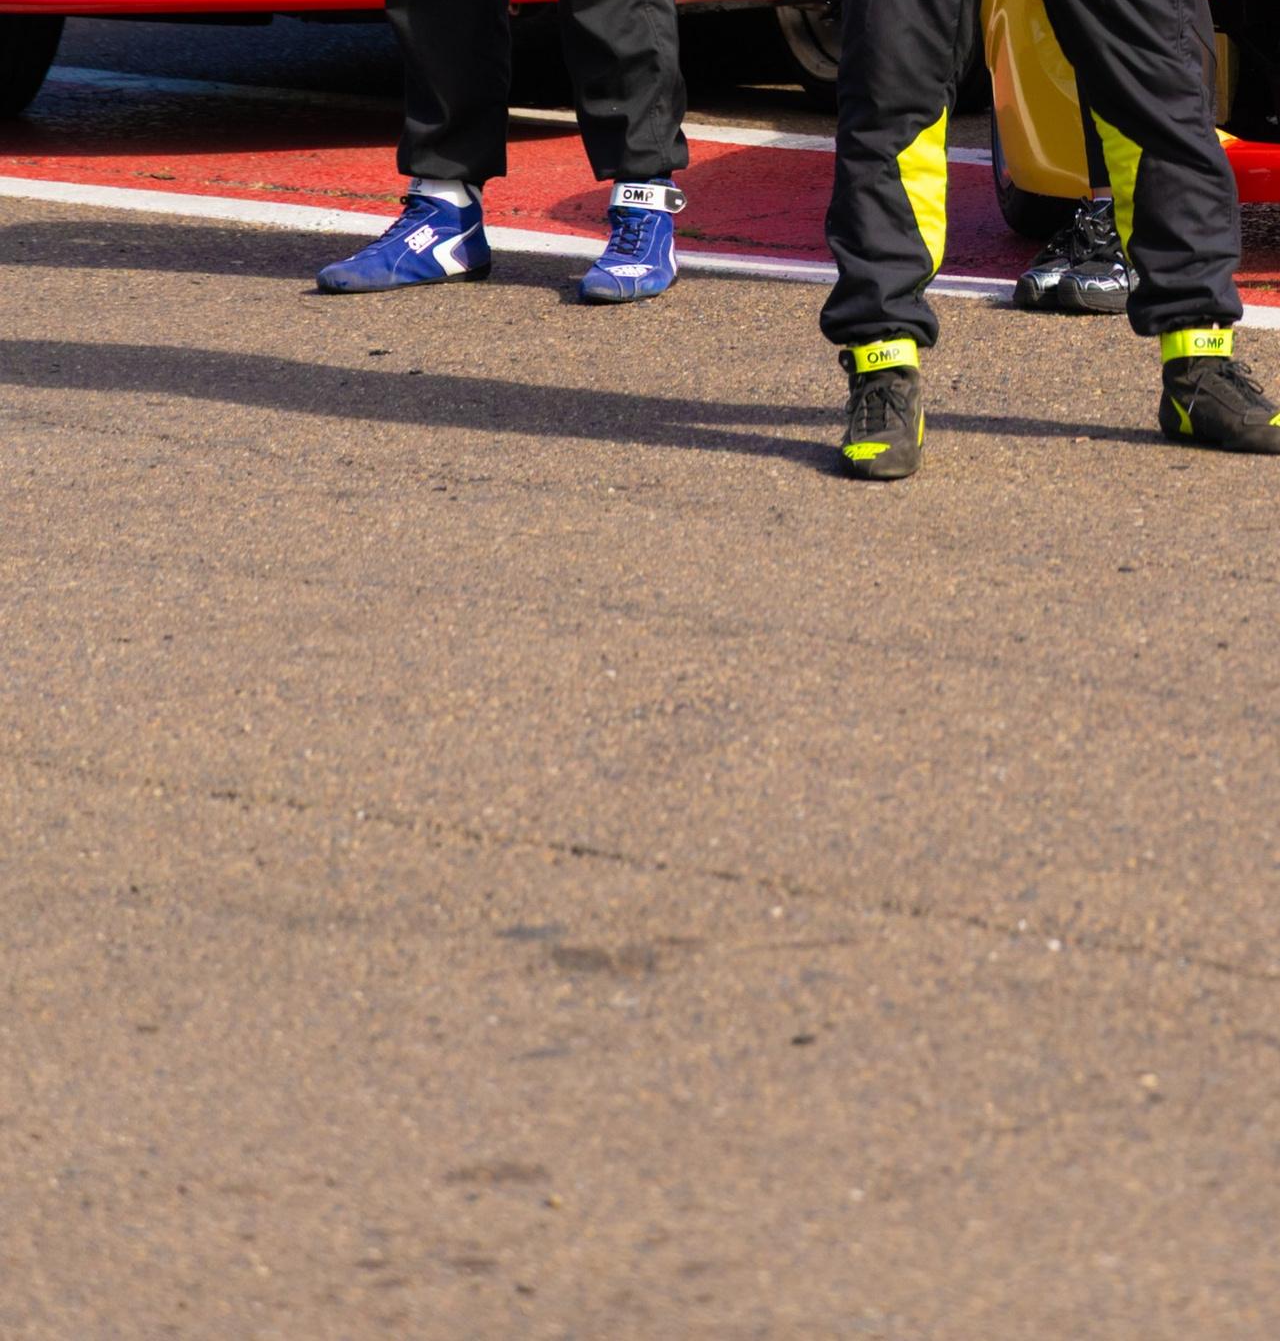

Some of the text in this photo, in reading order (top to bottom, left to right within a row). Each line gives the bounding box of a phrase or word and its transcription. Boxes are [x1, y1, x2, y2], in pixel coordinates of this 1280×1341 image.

[623, 189, 654, 202] OMP
[407, 225, 435, 251] OMP
[1194, 337, 1224, 349] OMP
[867, 348, 901, 364] OMP
